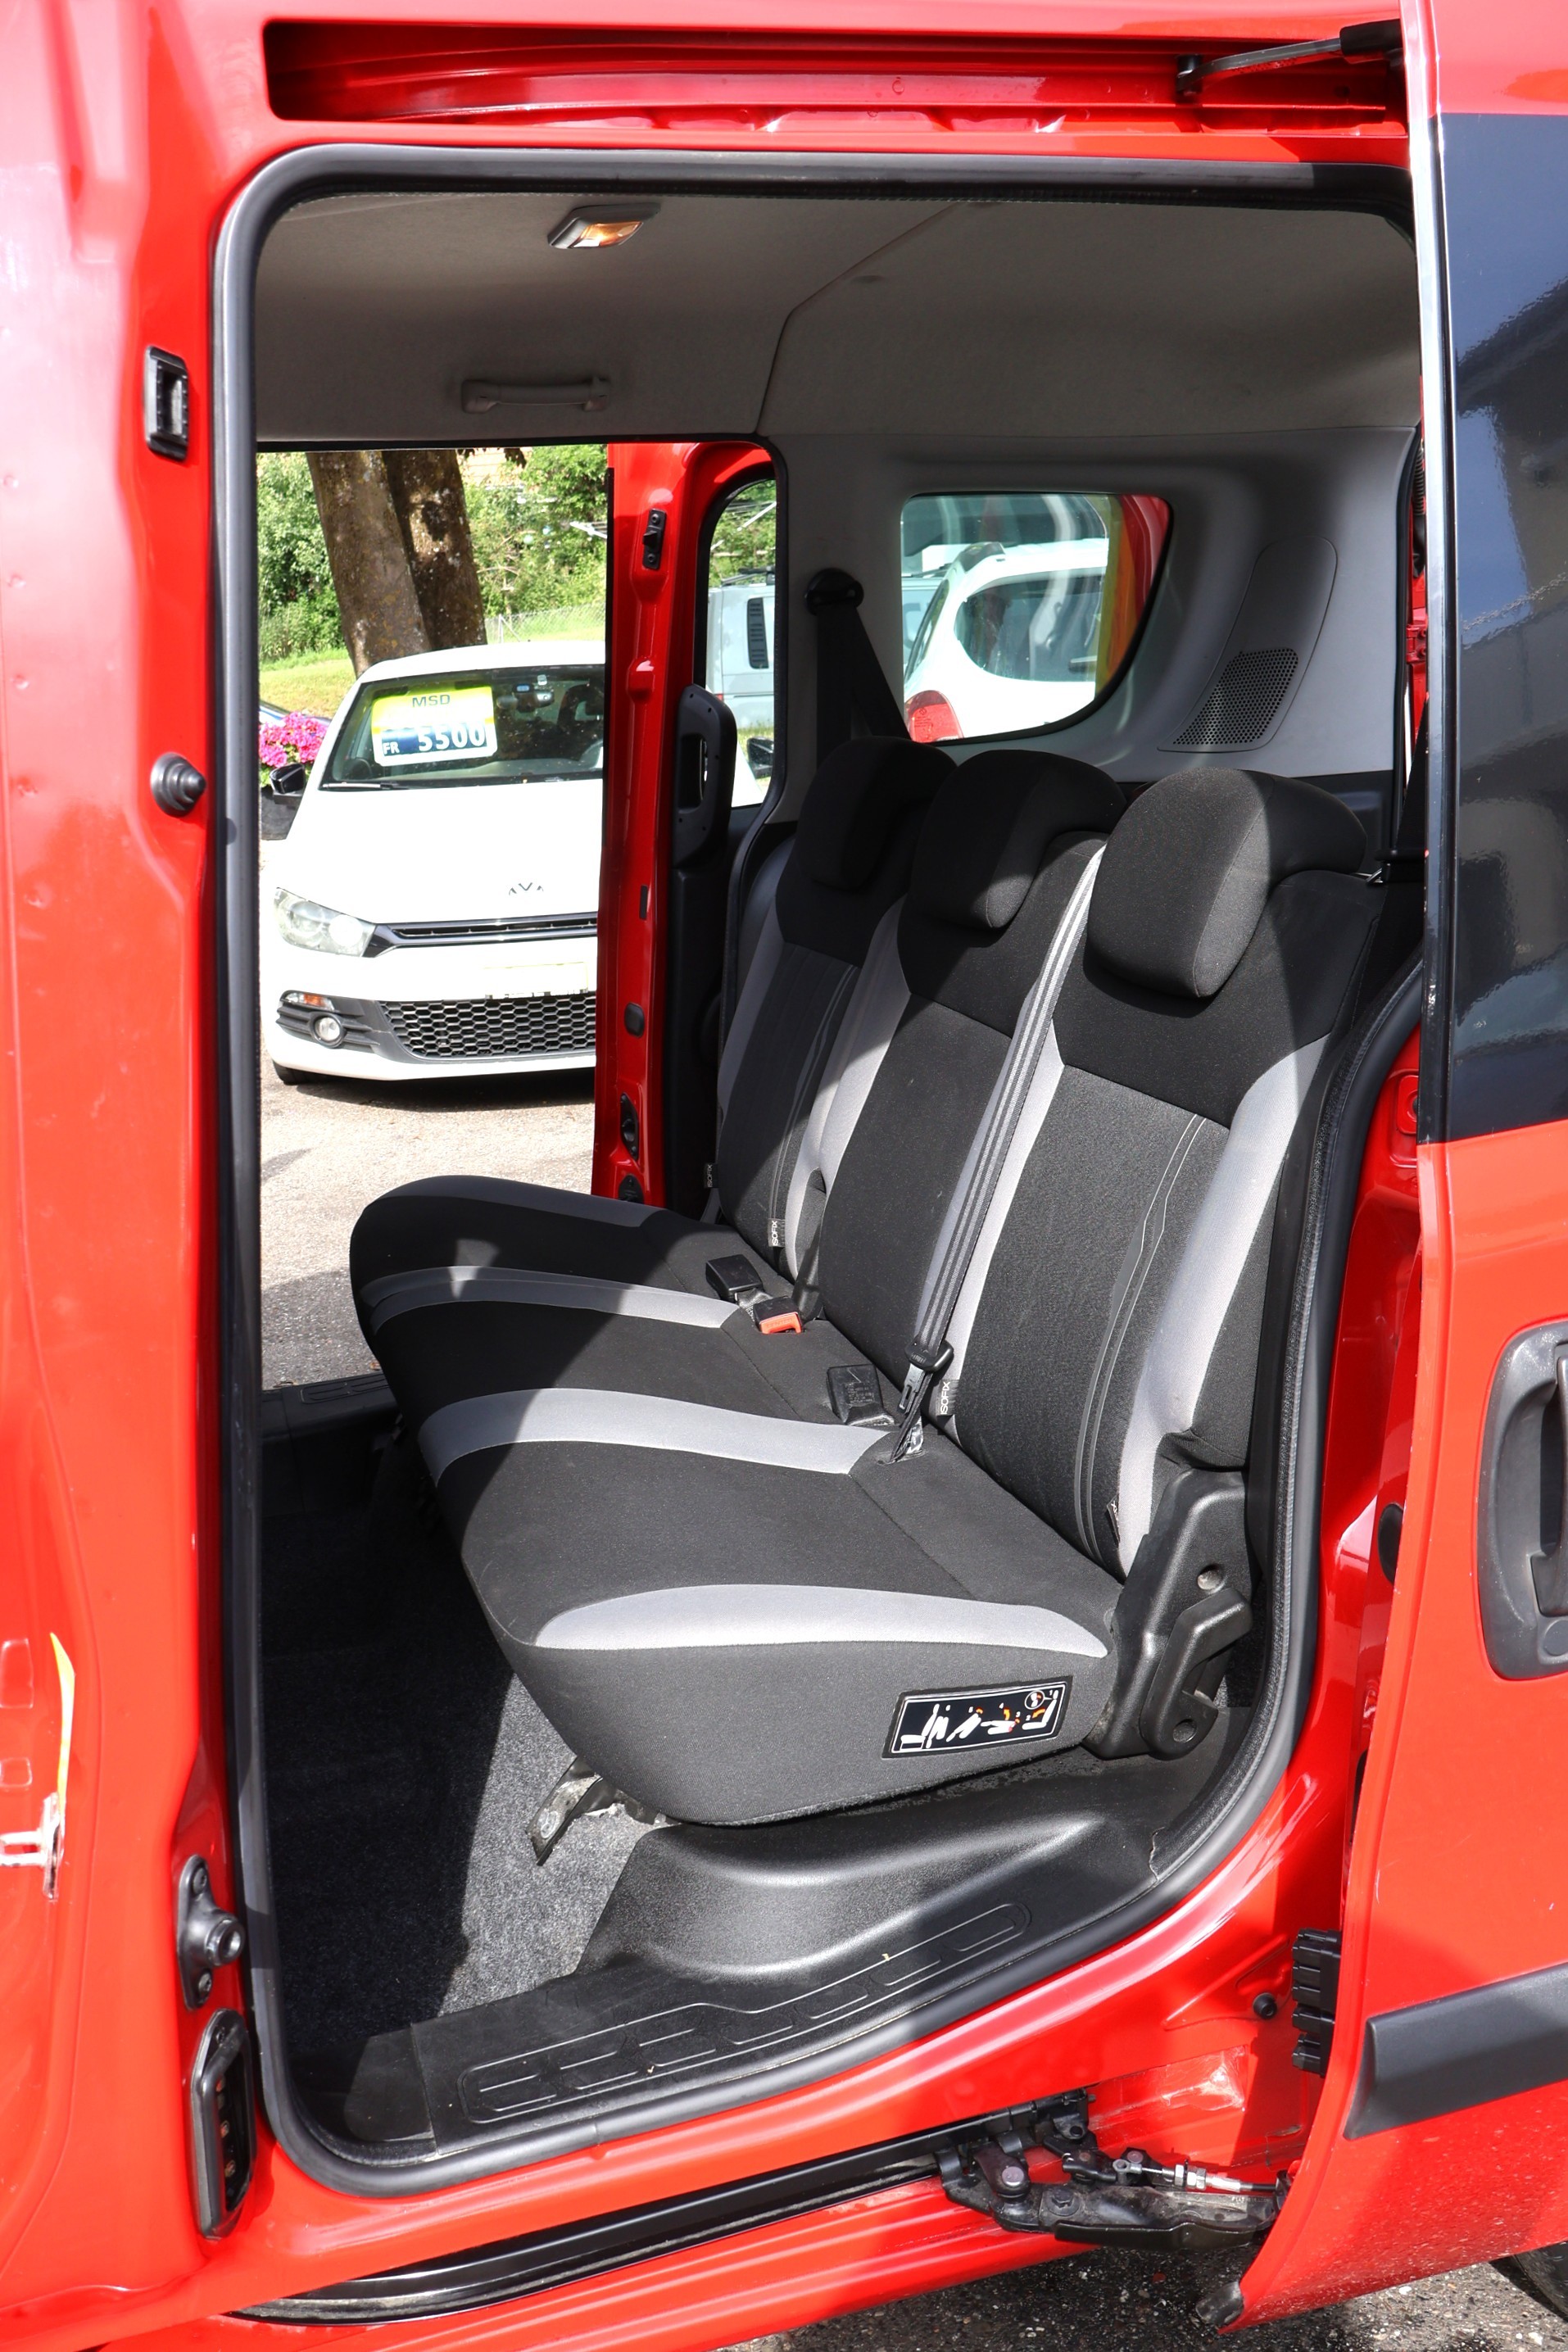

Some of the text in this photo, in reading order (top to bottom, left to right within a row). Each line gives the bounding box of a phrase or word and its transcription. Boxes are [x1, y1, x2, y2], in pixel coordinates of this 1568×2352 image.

[412, 695, 451, 707] MSD
[383, 723, 486, 754] FR 5500
[940, 1381, 951, 1415] ISOFIX
